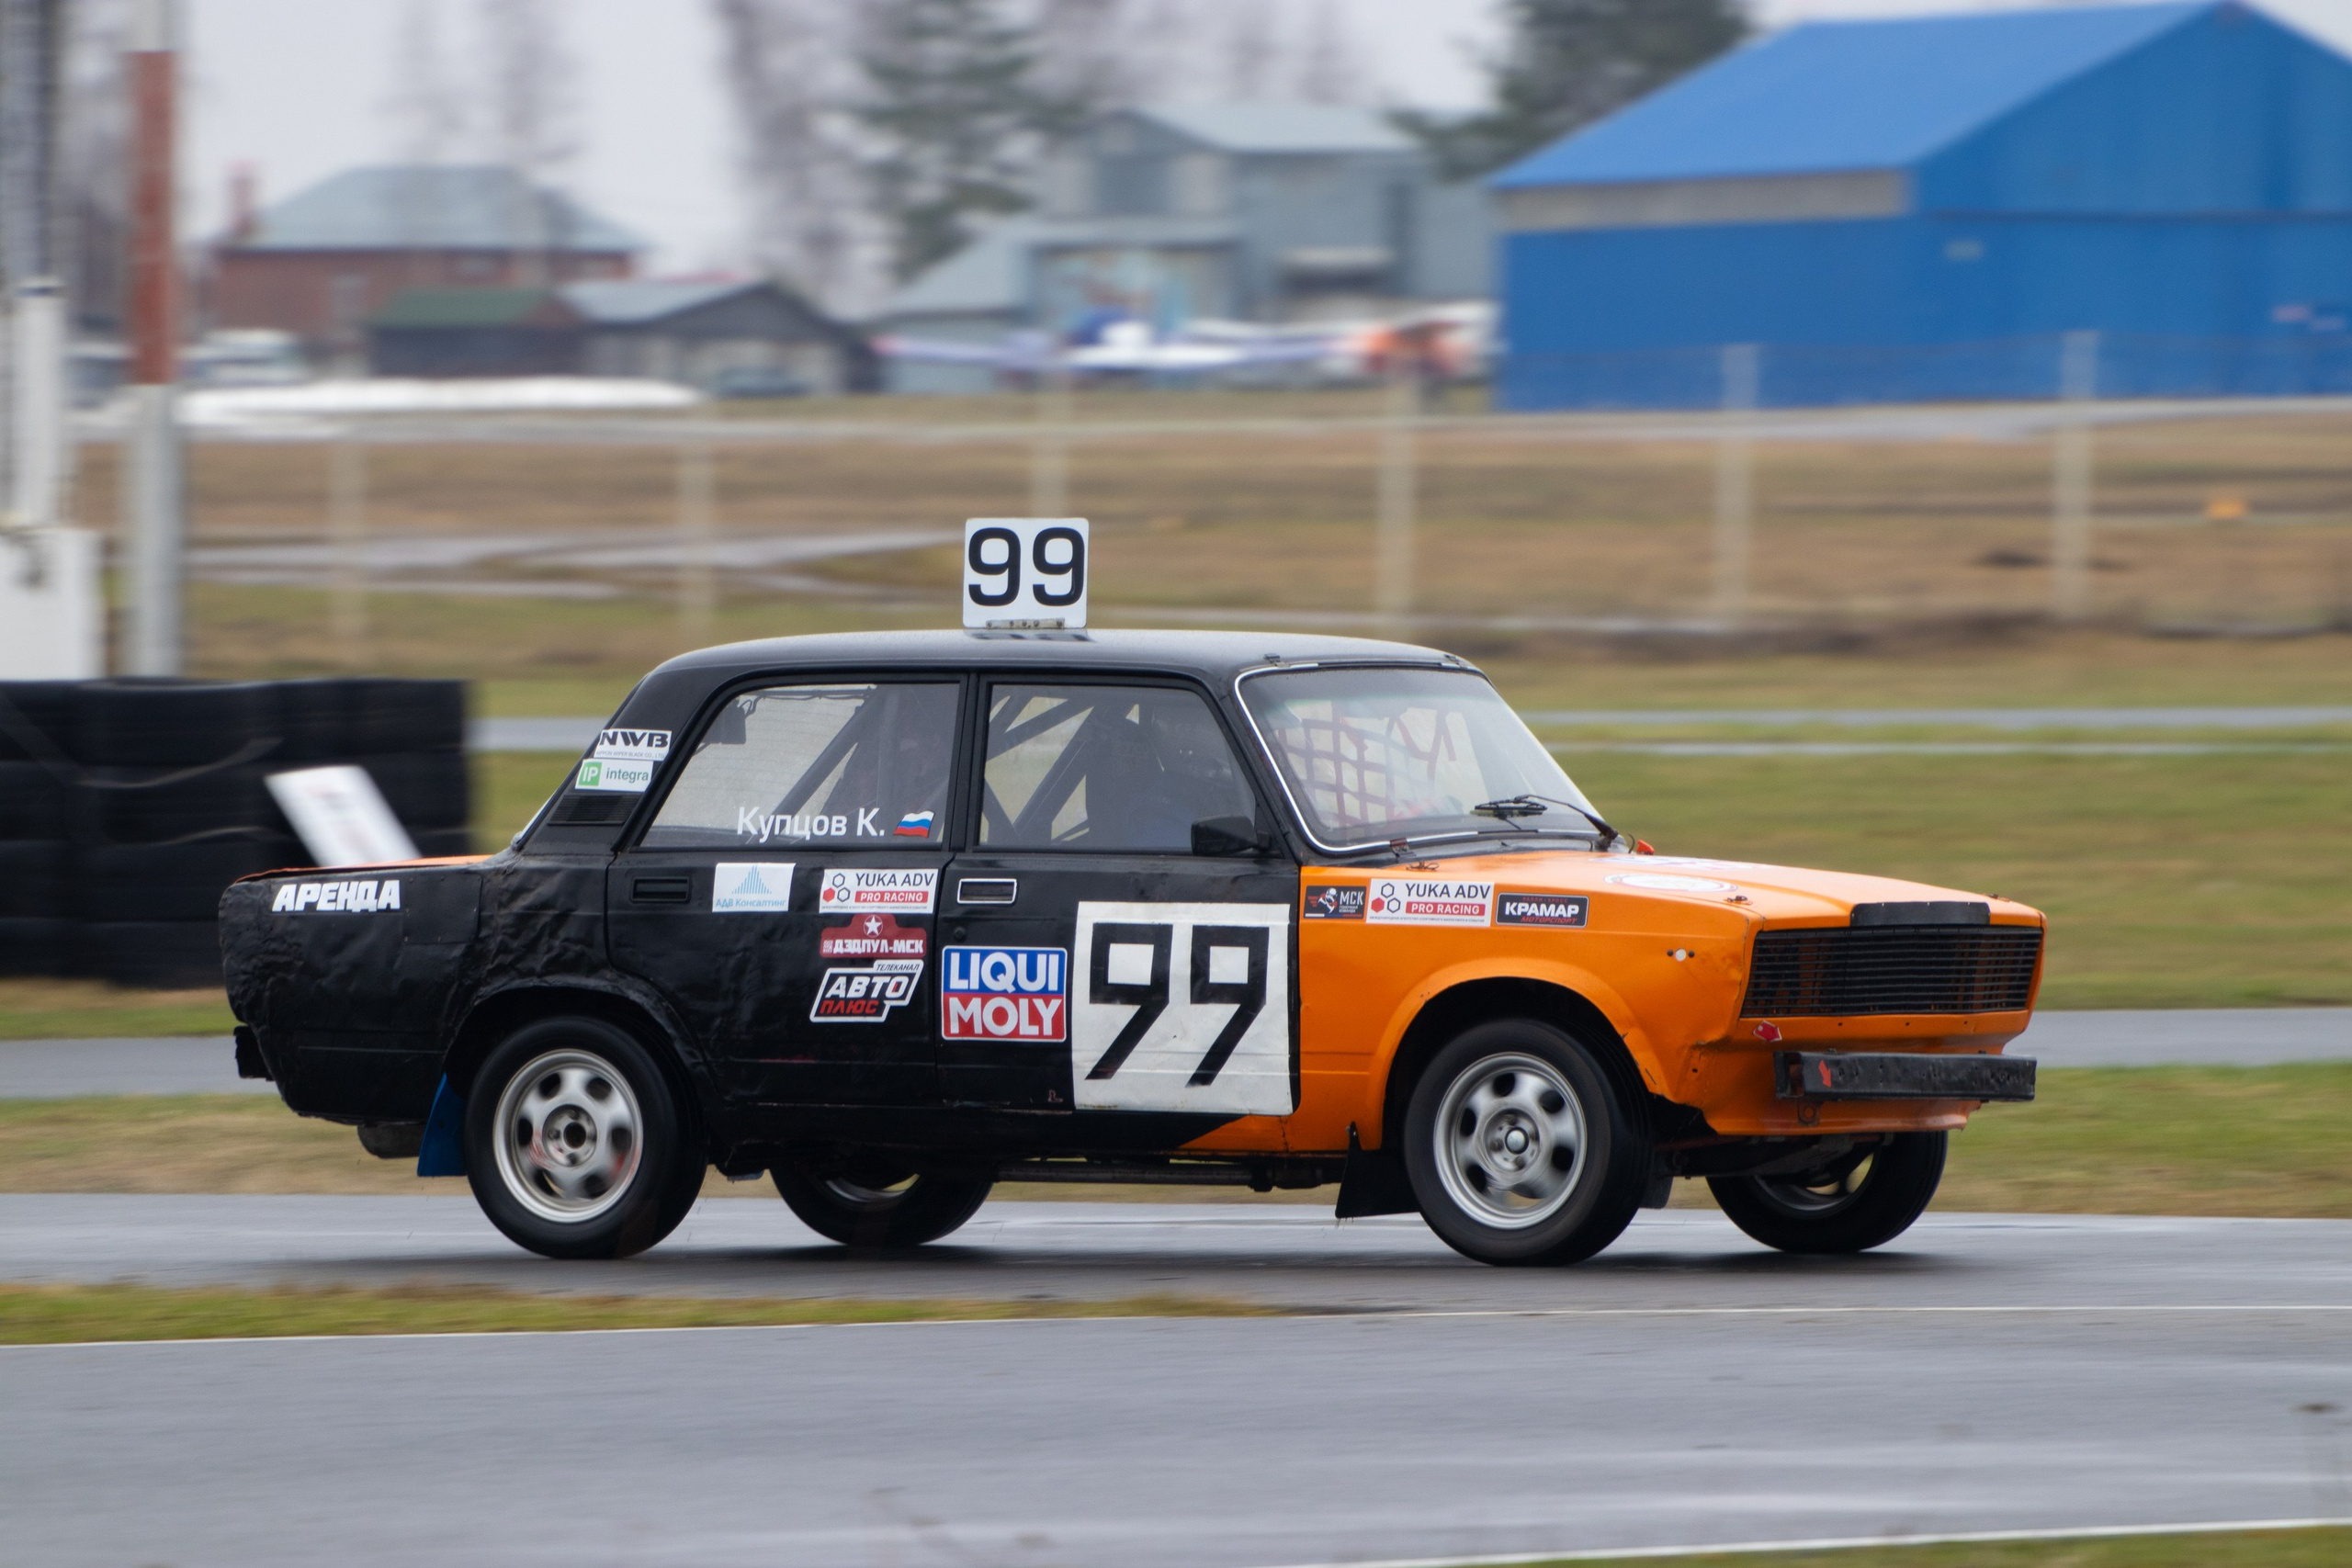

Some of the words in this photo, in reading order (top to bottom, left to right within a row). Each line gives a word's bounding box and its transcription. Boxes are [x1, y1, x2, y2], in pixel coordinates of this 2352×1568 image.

[968, 526, 1085, 607] 99
[599, 731, 669, 748] NWB
[582, 766, 599, 783] IP
[606, 768, 650, 784] integra
[736, 807, 848, 843] Купцов
[856, 807, 886, 837] К.
[855, 873, 898, 887] YUKA
[900, 873, 935, 887] ADV
[271, 879, 401, 913] АРЕНДА
[860, 892, 882, 903] PRO
[883, 892, 924, 903] RACING
[1340, 890, 1364, 906] МСК
[1405, 883, 1451, 897] YUKA
[1453, 885, 1490, 899] ADV
[716, 898, 733, 908] АДВ
[735, 898, 786, 908] Консалтинг
[1410, 903, 1434, 913] PRO
[1436, 904, 1480, 915] RACING
[1505, 902, 1579, 918] КРАМАР
[1521, 916, 1577, 924] МОТОРСПОРТ
[832, 939, 924, 954] ДЭДПУЛ-МСК
[876, 964, 920, 972] ТЕЛЕКАНАЛ
[949, 952, 1059, 994] LIQUI
[825, 976, 910, 998] АВТО
[820, 1000, 879, 1015] ПЛЮС
[1084, 922, 1270, 1089] 99
[949, 997, 1062, 1036] MOLY
